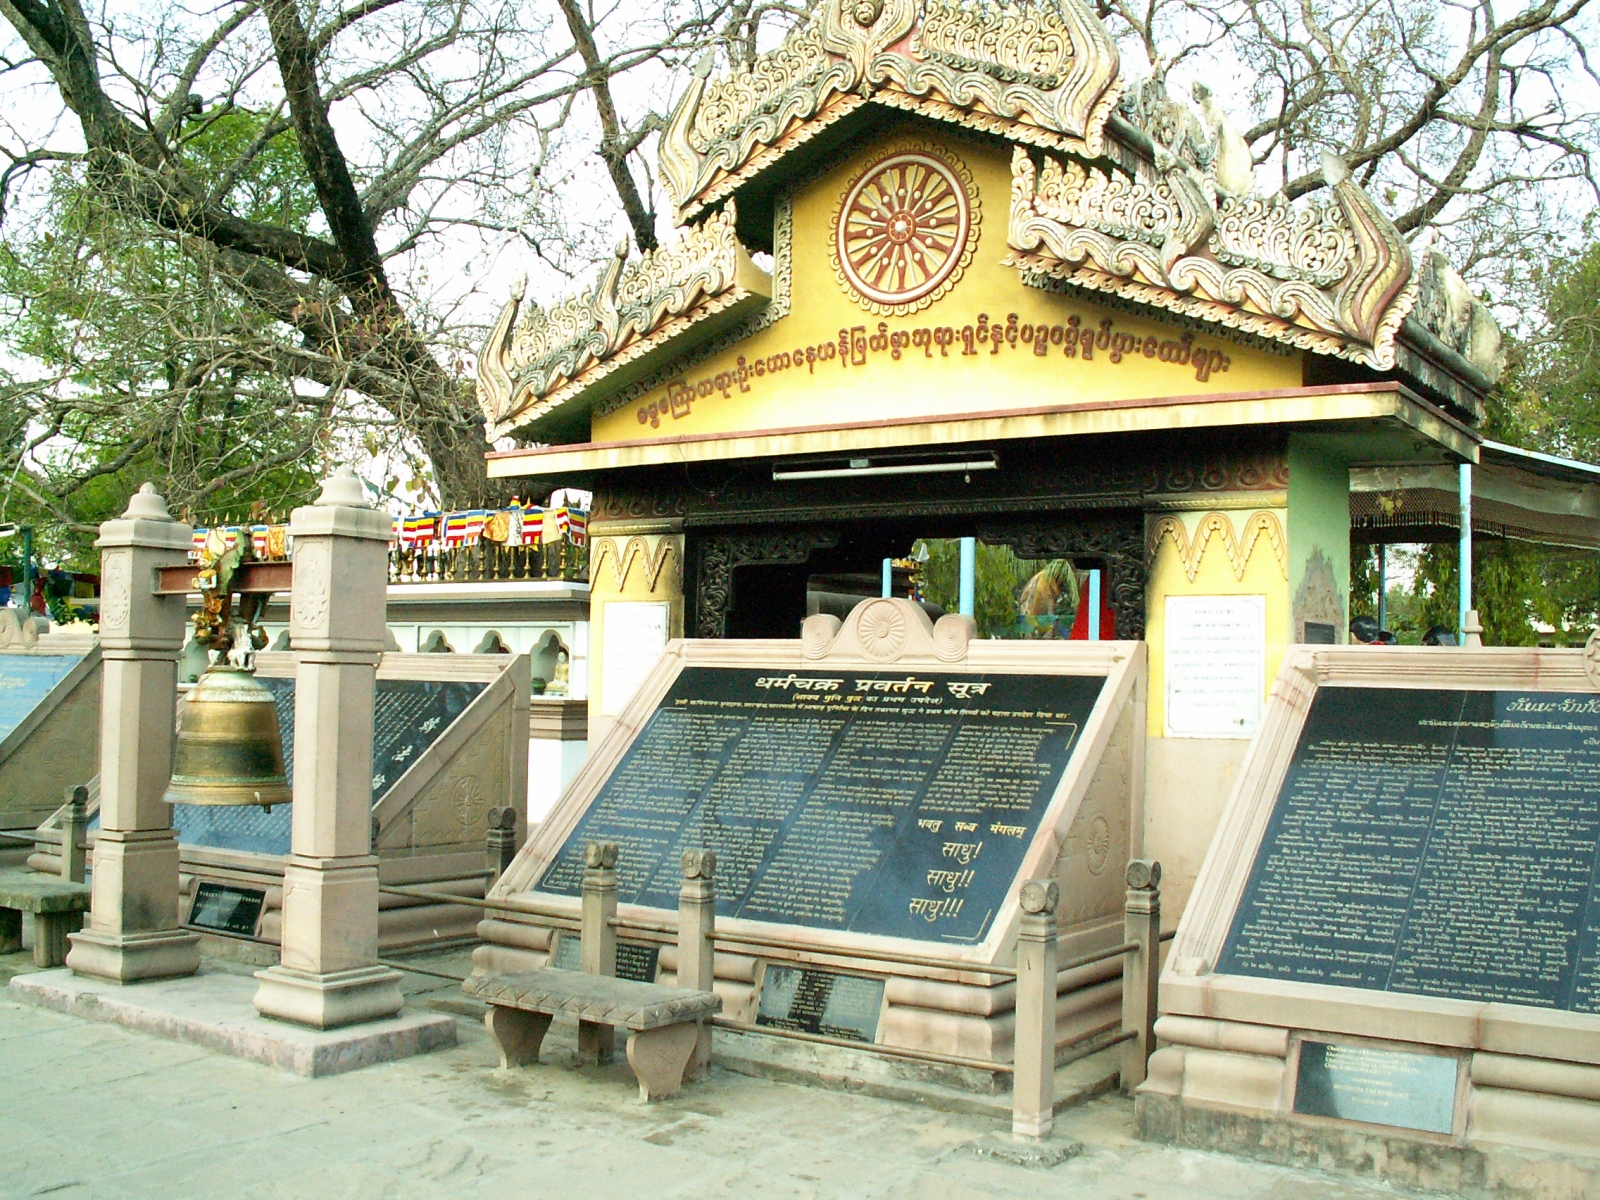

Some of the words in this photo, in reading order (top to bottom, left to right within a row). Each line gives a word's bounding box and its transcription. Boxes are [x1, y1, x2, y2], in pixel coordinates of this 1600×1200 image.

[754, 673, 844, 691] धर्मचक्र
[854, 676, 935, 693] प्रवर्तन
[946, 680, 992, 699] सूत्र
[917, 818, 943, 833] भवतु
[990, 821, 1027, 840] मंगलम्
[942, 841, 983, 864] साधु!
[926, 869, 975, 893] साधु!!
[908, 897, 965, 922] साधु!!!
